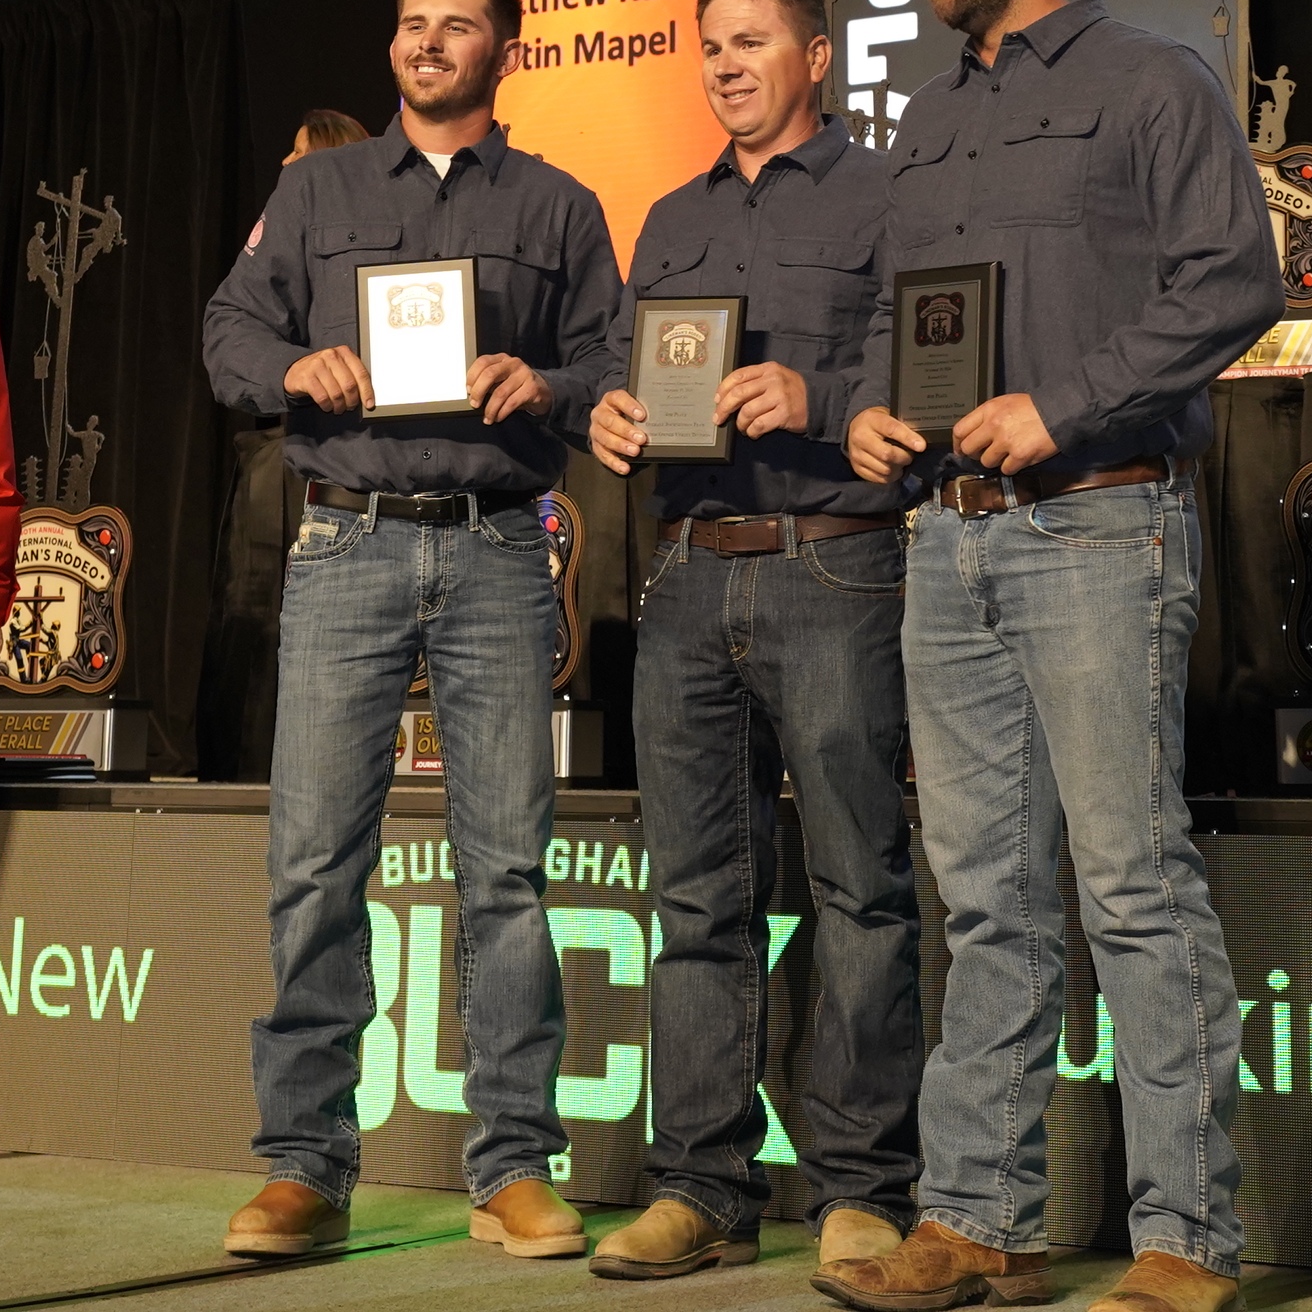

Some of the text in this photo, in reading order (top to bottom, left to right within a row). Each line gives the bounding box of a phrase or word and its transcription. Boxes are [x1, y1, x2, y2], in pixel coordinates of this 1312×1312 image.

[574, 20, 676, 67] Mapel
[1264, 188, 1303, 209] ODEO
[1219, 370, 1248, 378] AMPION
[1249, 368, 1300, 376] JOURNEYMAN
[20, 526, 65, 536] 0TH ANNUAL
[18, 537, 73, 550] TERNATIONAL
[55, 550, 99, 579] RODEO
[5, 715, 53, 732] PLACE
[417, 717, 434, 734] 1S
[415, 761, 443, 769] JOURNEY
